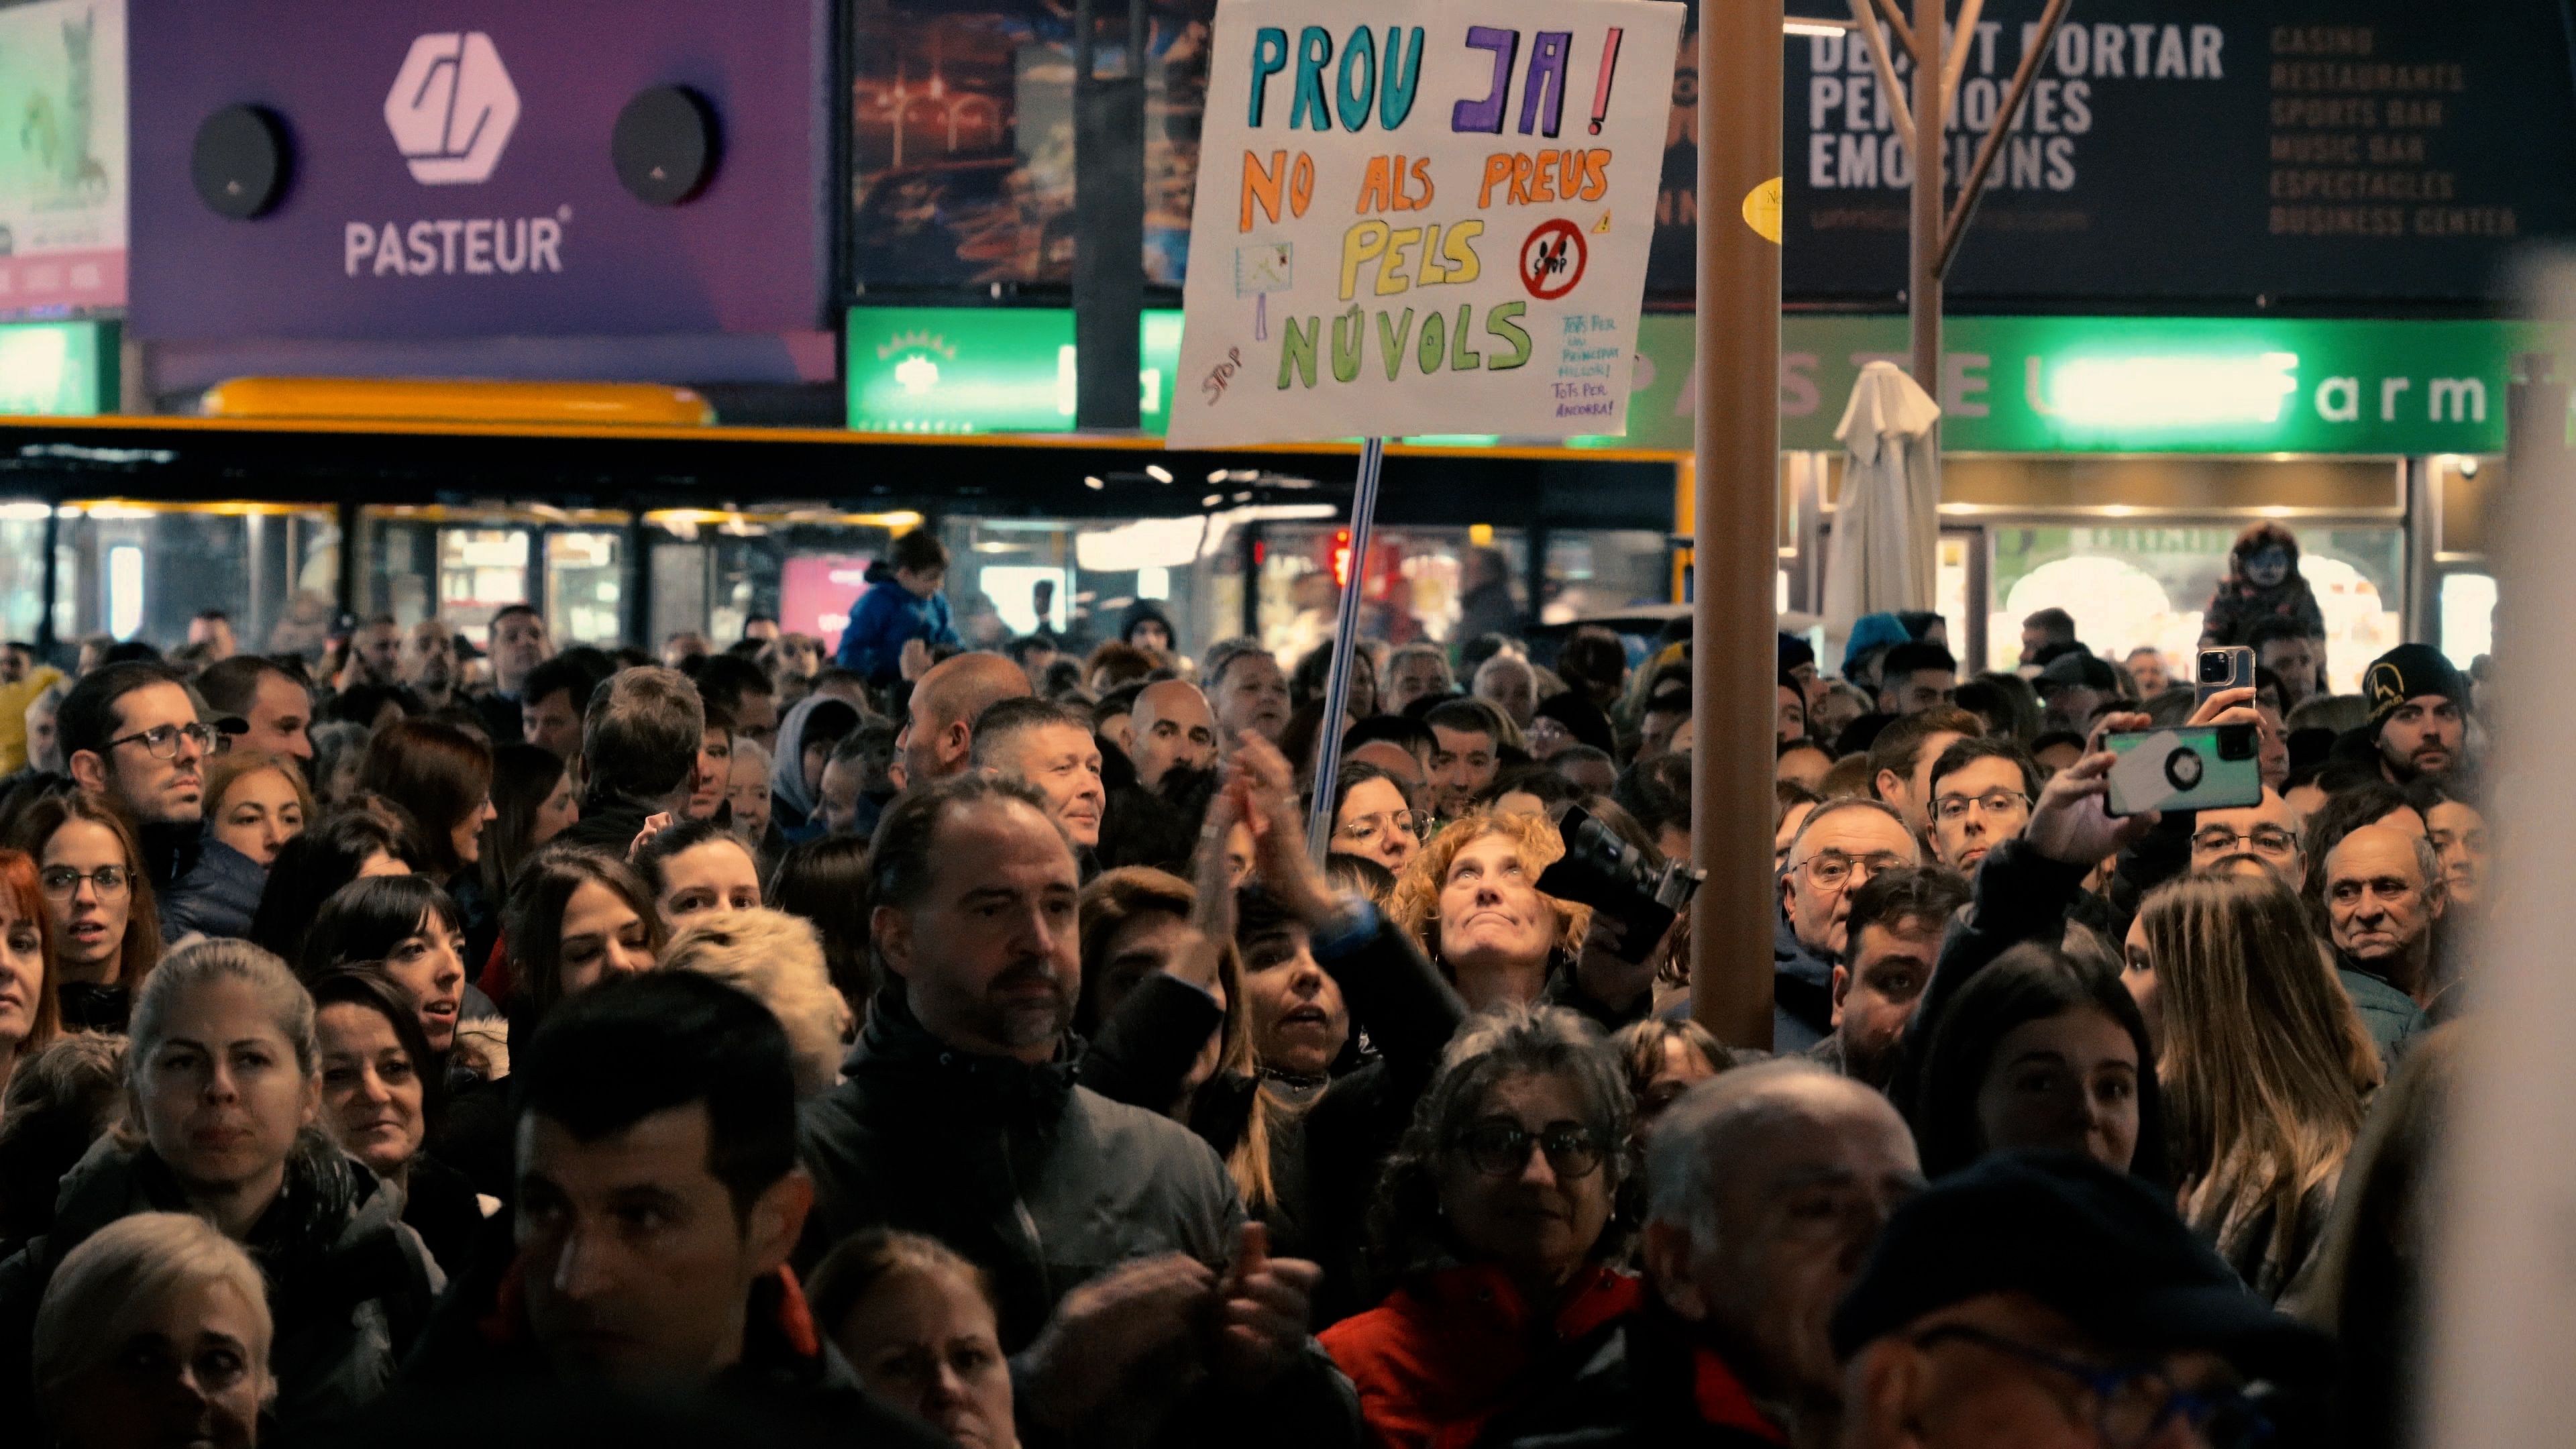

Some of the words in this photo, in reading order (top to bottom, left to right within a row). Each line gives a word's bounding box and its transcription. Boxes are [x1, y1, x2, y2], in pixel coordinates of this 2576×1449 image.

[2271, 26, 2373, 55] CASINO
[1248, 24, 1425, 133] PROU
[2270, 62, 2463, 91] RESTAURANTS
[2270, 99, 2377, 128] SPORTS
[2387, 99, 2443, 128] BAR
[1811, 133, 2077, 190] EMOIONS
[2270, 135, 2358, 162] MUSIC
[2369, 136, 2424, 163] BAR
[1240, 149, 1315, 233] NO
[1356, 154, 1434, 215] ALS
[1478, 148, 1611, 209] PREUS
[345, 216, 564, 276] PASTEUR
[2269, 205, 2403, 235] BUSINESS
[2414, 207, 2516, 237] CENTER
[1339, 219, 1484, 301] PELS
[1534, 257, 1567, 276] STOP
[1277, 301, 1533, 390] NÚVOLS
[1201, 346, 1242, 406] STOP
